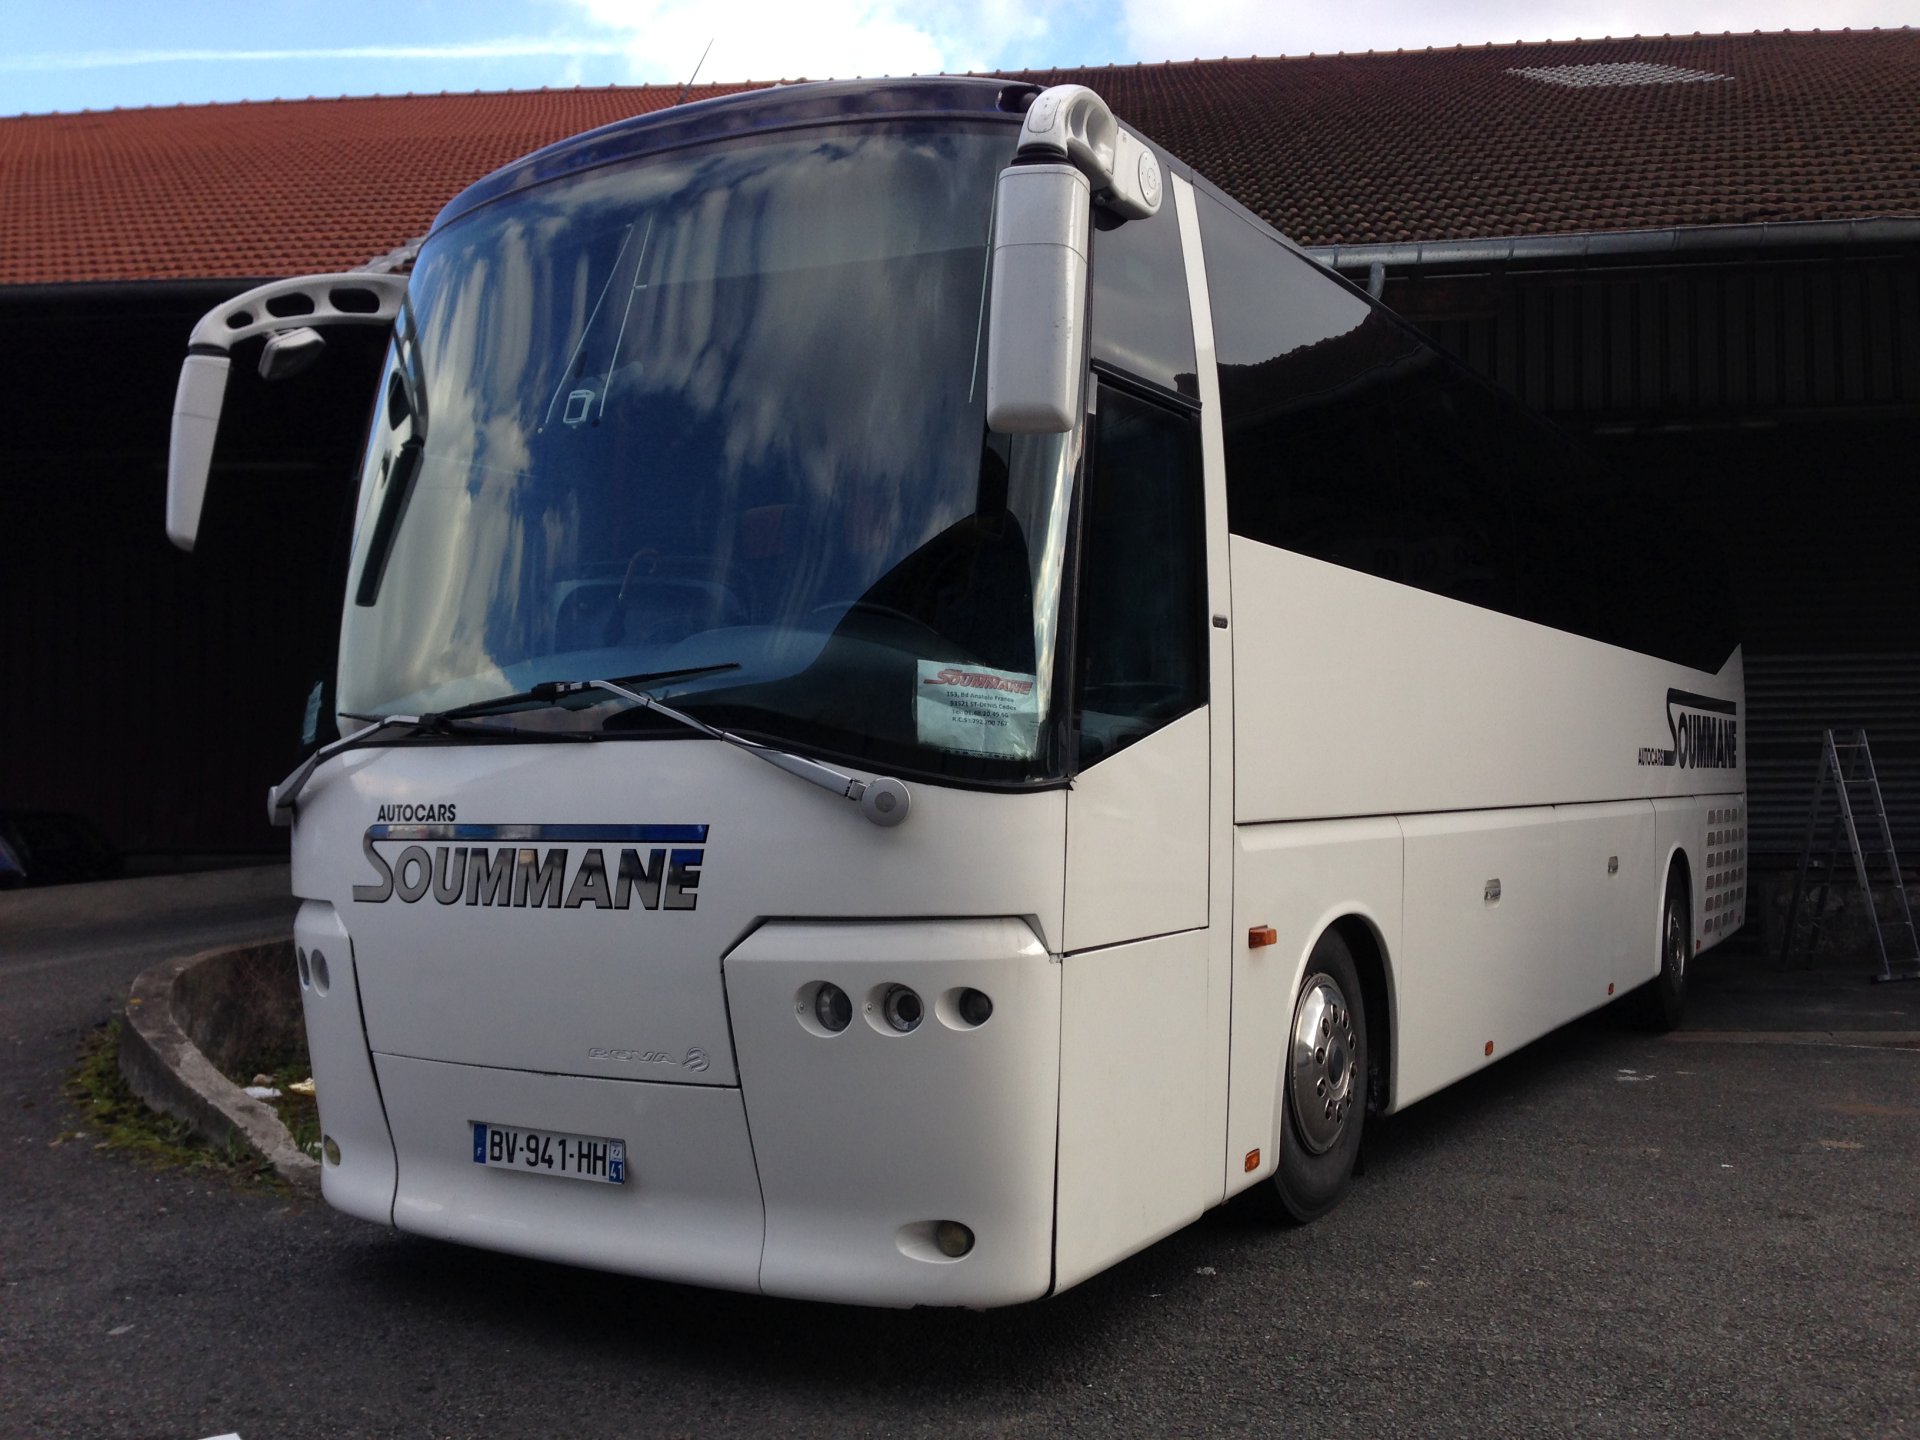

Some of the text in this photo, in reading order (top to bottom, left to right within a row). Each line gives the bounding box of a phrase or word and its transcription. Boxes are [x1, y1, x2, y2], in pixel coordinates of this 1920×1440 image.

[923, 668, 1034, 695] SOUMMANE
[1638, 688, 1736, 769] AUTOCARS SOUMMANE
[377, 803, 456, 822] AUTOCARS
[353, 824, 709, 911] SOUMMANE
[588, 1048, 677, 1064] BOVA
[490, 1130, 607, 1176] BV-941-HH
[610, 1164, 623, 1180] 41
